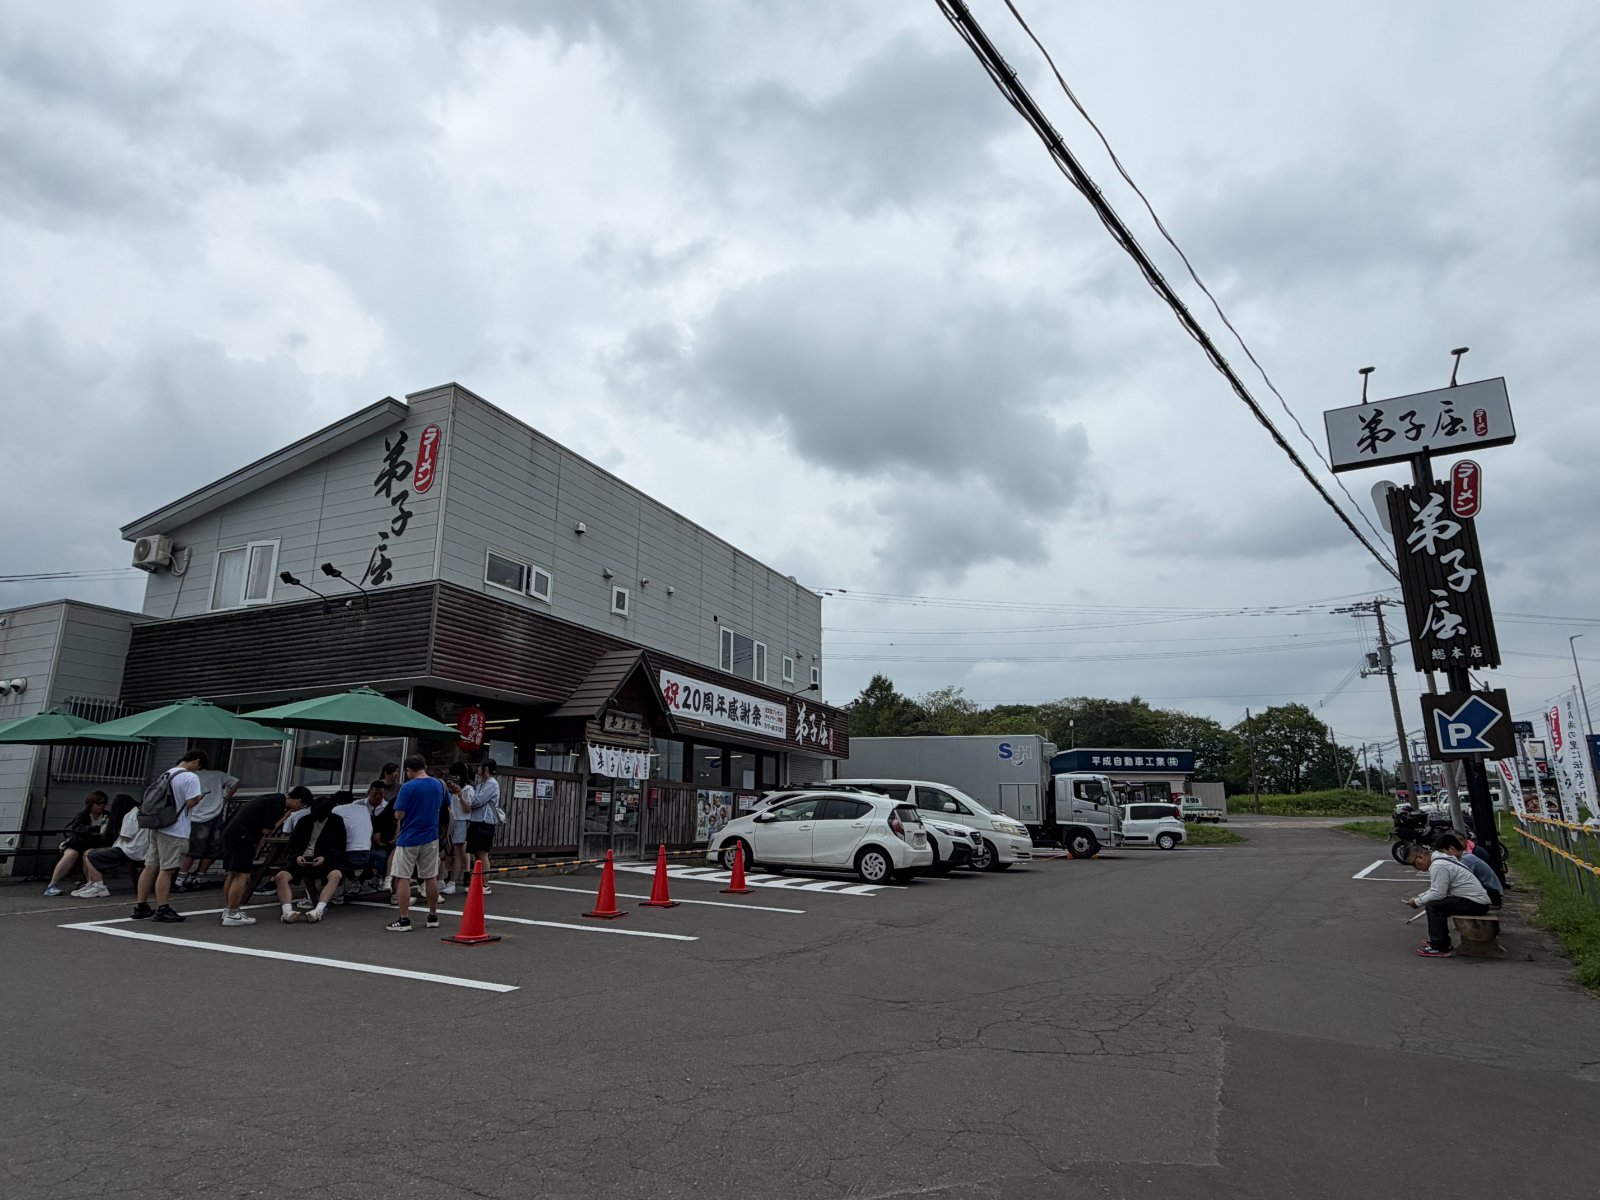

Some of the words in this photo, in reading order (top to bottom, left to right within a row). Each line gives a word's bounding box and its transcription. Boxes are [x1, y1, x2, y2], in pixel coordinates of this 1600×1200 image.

[1474, 409, 1487, 436] ラーメン
[415, 426, 437, 489] ラーメン
[1456, 463, 1475, 512] ラーメン
[1431, 645, 1483, 660] 総本店
[1448, 723, 1472, 747] P
